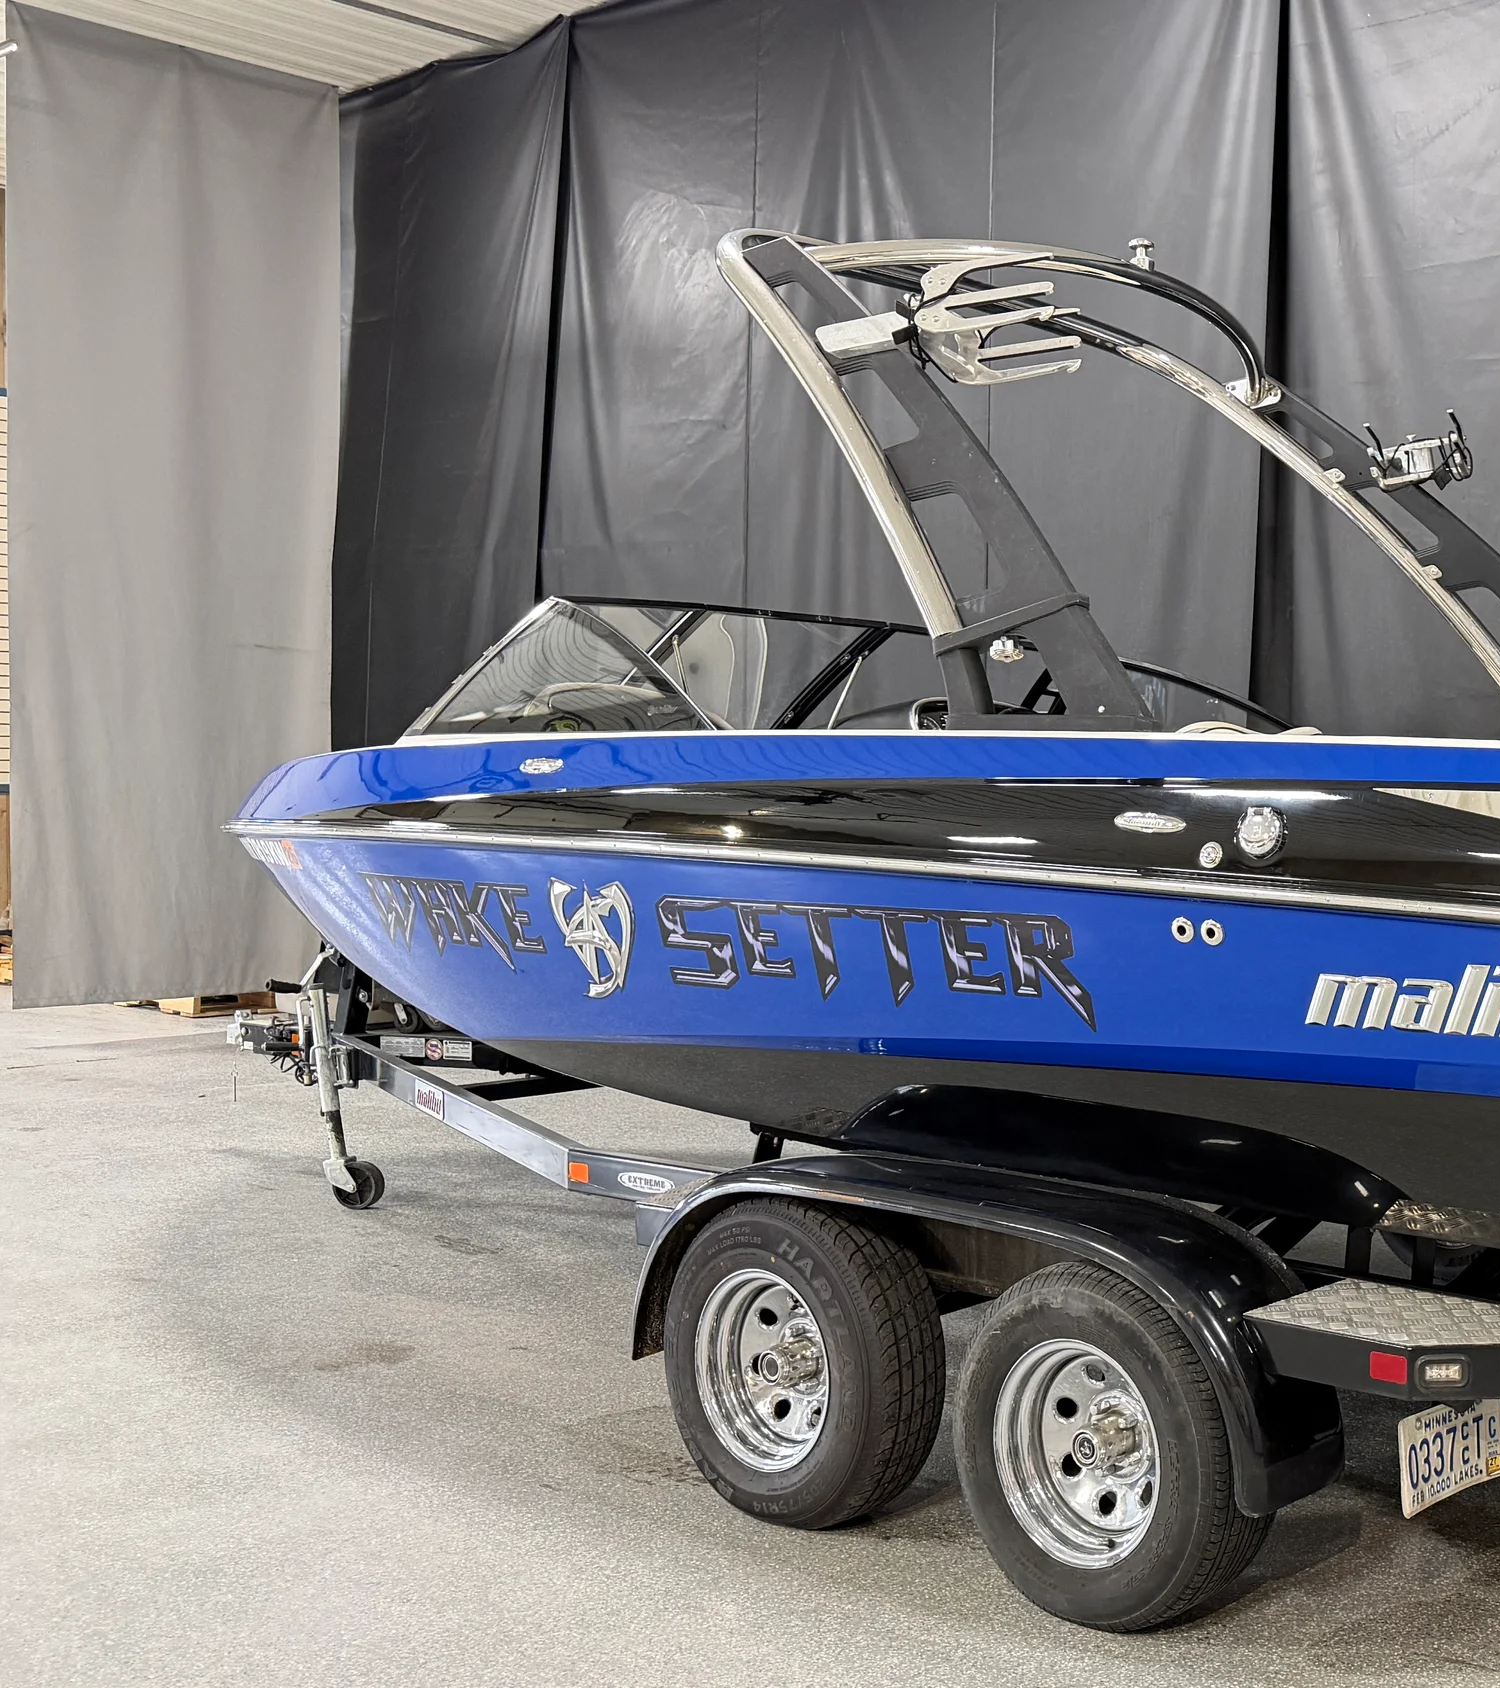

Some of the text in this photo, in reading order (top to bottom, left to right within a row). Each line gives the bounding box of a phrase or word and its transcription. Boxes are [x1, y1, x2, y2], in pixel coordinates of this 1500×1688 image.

[357, 871, 1098, 1033] WAKE SETTER
[416, 1088, 442, 1116] malibu
[627, 1174, 666, 1189] EXTREME
[777, 1237, 857, 1432] HARTLAND
[1408, 1425, 1457, 1490] 0337
